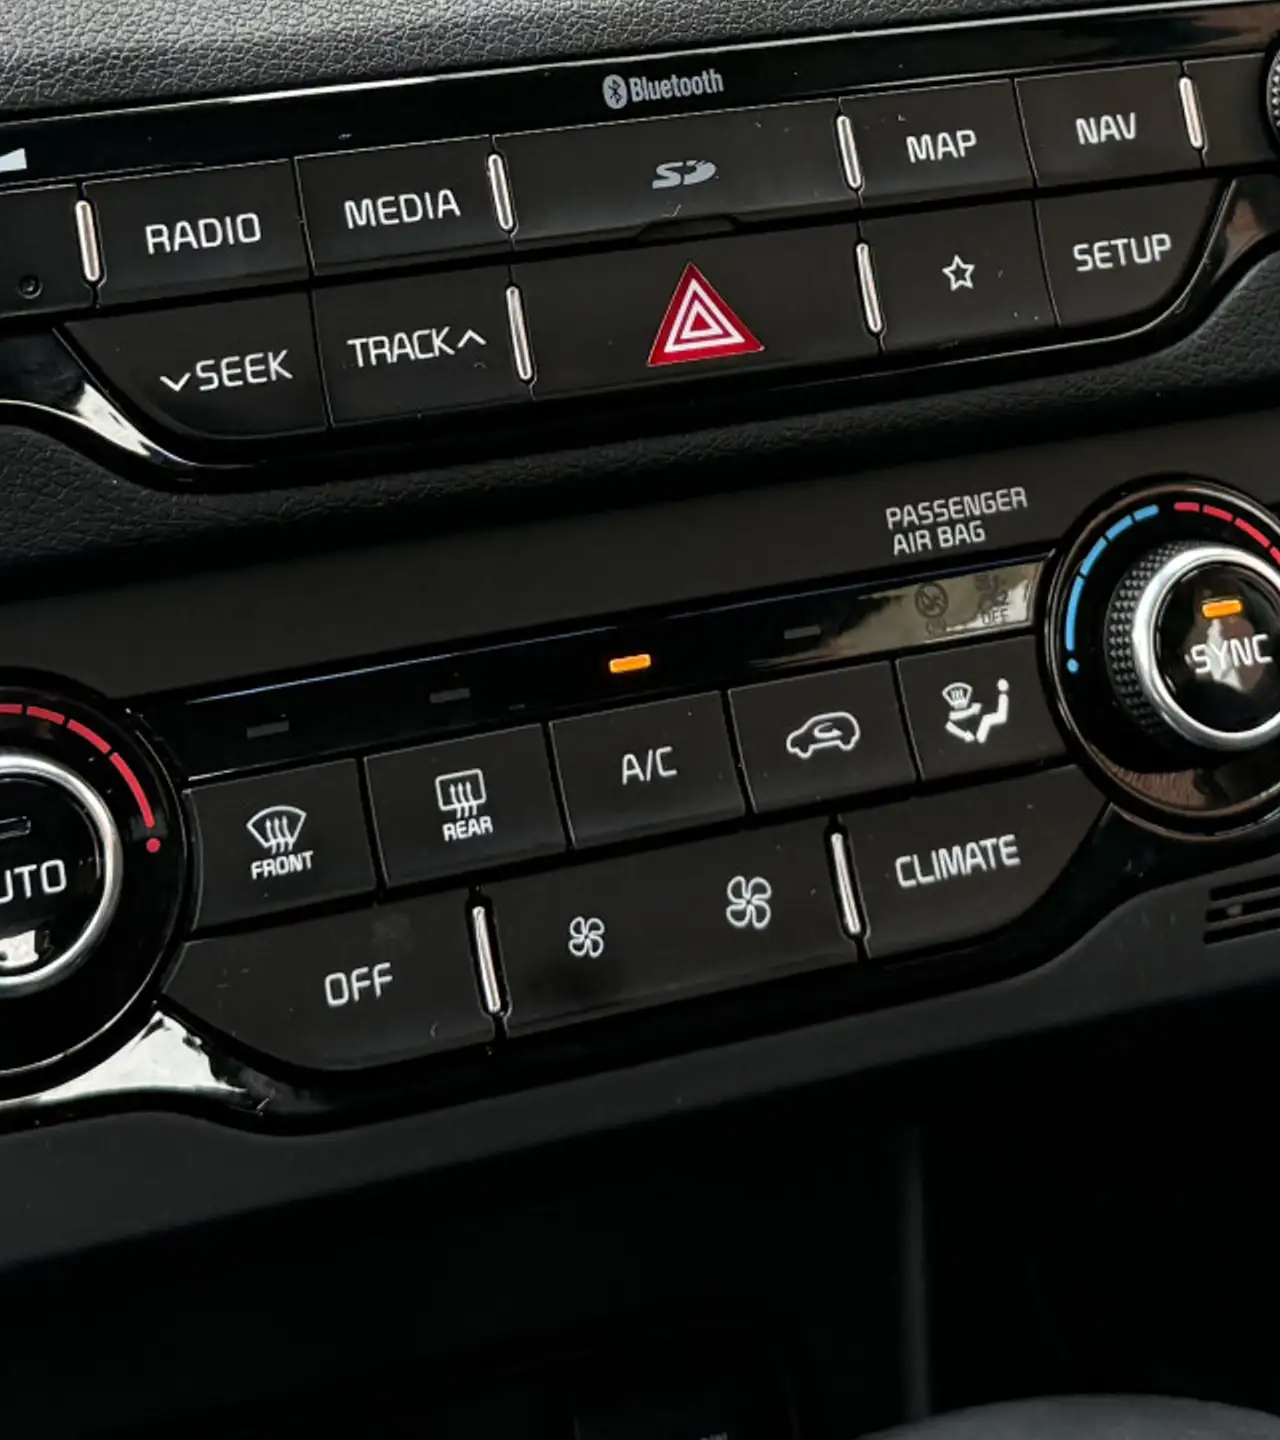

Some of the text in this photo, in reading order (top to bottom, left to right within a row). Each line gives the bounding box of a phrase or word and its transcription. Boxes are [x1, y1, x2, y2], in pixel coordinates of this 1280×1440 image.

[628, 67, 725, 105] Bluetooth
[905, 129, 978, 163] MAP
[1074, 112, 1139, 147] NAV
[343, 189, 462, 230] MEDIA
[145, 213, 263, 255] RADIO
[1072, 233, 1172, 273] SETUP
[347, 326, 457, 369] TRACK
[195, 348, 295, 393] SEEK
[885, 486, 1029, 531] PASSENGER
[892, 519, 987, 557] AIR BAG
[1190, 634, 1273, 676] SYNC
[621, 746, 678, 786] A/C
[441, 815, 494, 842] REAR
[250, 849, 315, 879] FRONT
[895, 833, 1021, 889] CLIMATE
[324, 962, 394, 1008] OFF
